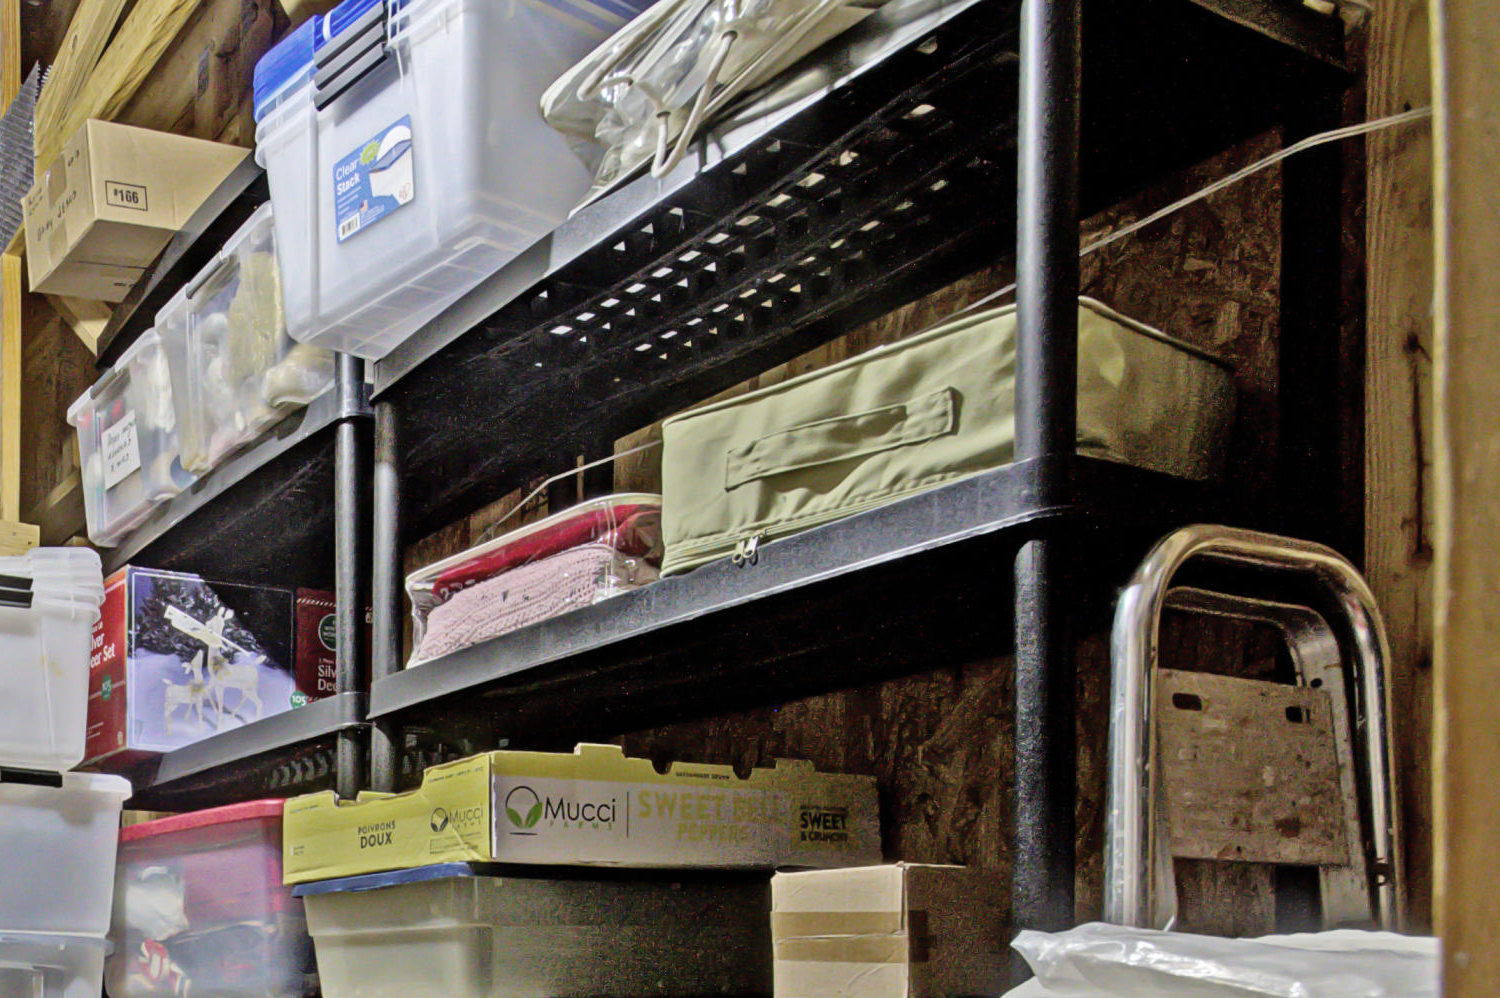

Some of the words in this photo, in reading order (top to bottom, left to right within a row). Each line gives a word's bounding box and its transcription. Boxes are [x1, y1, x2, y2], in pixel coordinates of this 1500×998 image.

[336, 158, 358, 181] Clear
[337, 172, 360, 196] Stack
[113, 187, 139, 204] #166
[90, 651, 103, 669] eer
[103, 642, 116, 662] Set
[318, 664, 337, 678] Silv
[292, 695, 307, 706] 105
[451, 807, 483, 821] Mucci
[544, 796, 615, 822] Mucci
[638, 790, 726, 821] SWEET
[358, 820, 396, 835] POIVRONS
[801, 811, 846, 829] SWEET
[360, 832, 393, 849] DOUX
